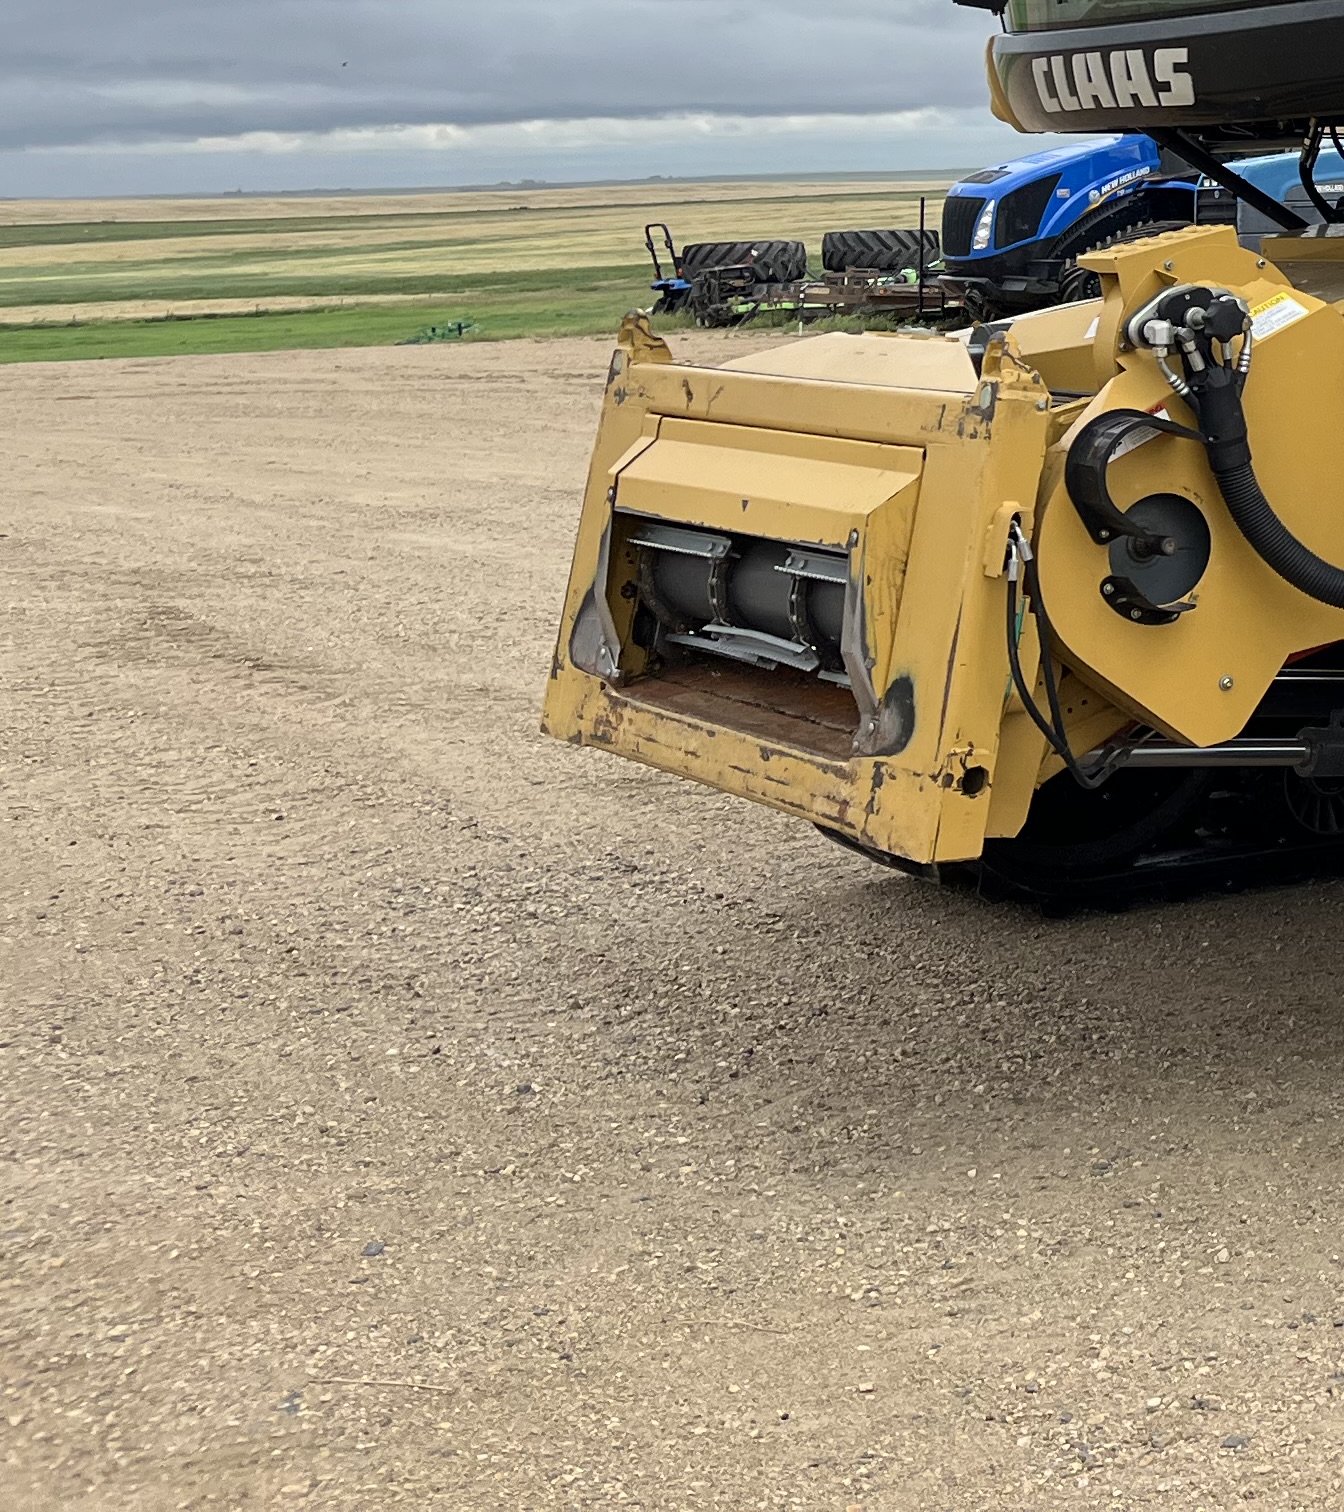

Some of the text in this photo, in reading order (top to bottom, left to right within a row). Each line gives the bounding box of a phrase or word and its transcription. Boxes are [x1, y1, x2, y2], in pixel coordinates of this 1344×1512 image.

[1031, 47, 1196, 113] CLAAS
[1101, 165, 1150, 195] NEW HOLLAND
